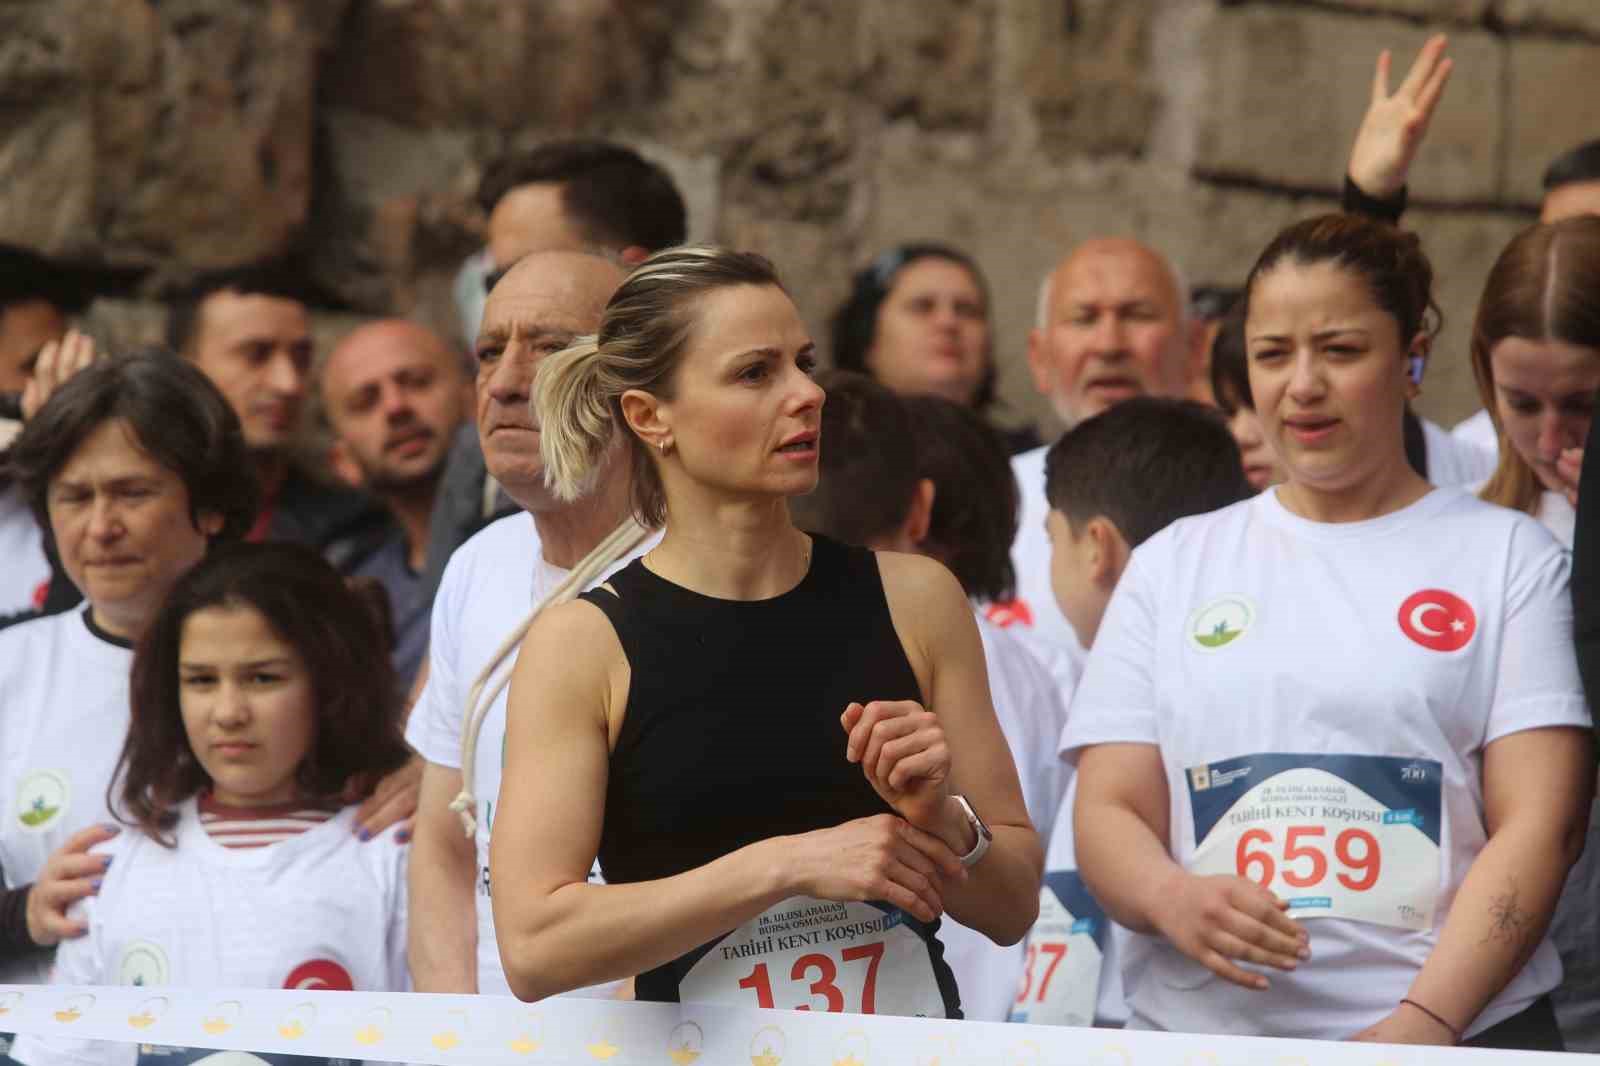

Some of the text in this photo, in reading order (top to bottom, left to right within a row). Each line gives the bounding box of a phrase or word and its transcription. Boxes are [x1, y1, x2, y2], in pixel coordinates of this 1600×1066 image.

[1275, 806, 1316, 819] KENT
[1322, 807, 1380, 823] KOŞUSU
[1236, 825, 1381, 891] 659
[720, 936, 774, 960] TARİHİ
[778, 931, 823, 949] KENT
[827, 919, 882, 940] KOŞUSU
[759, 922, 791, 936] BURSA
[739, 942, 885, 1014] 137
